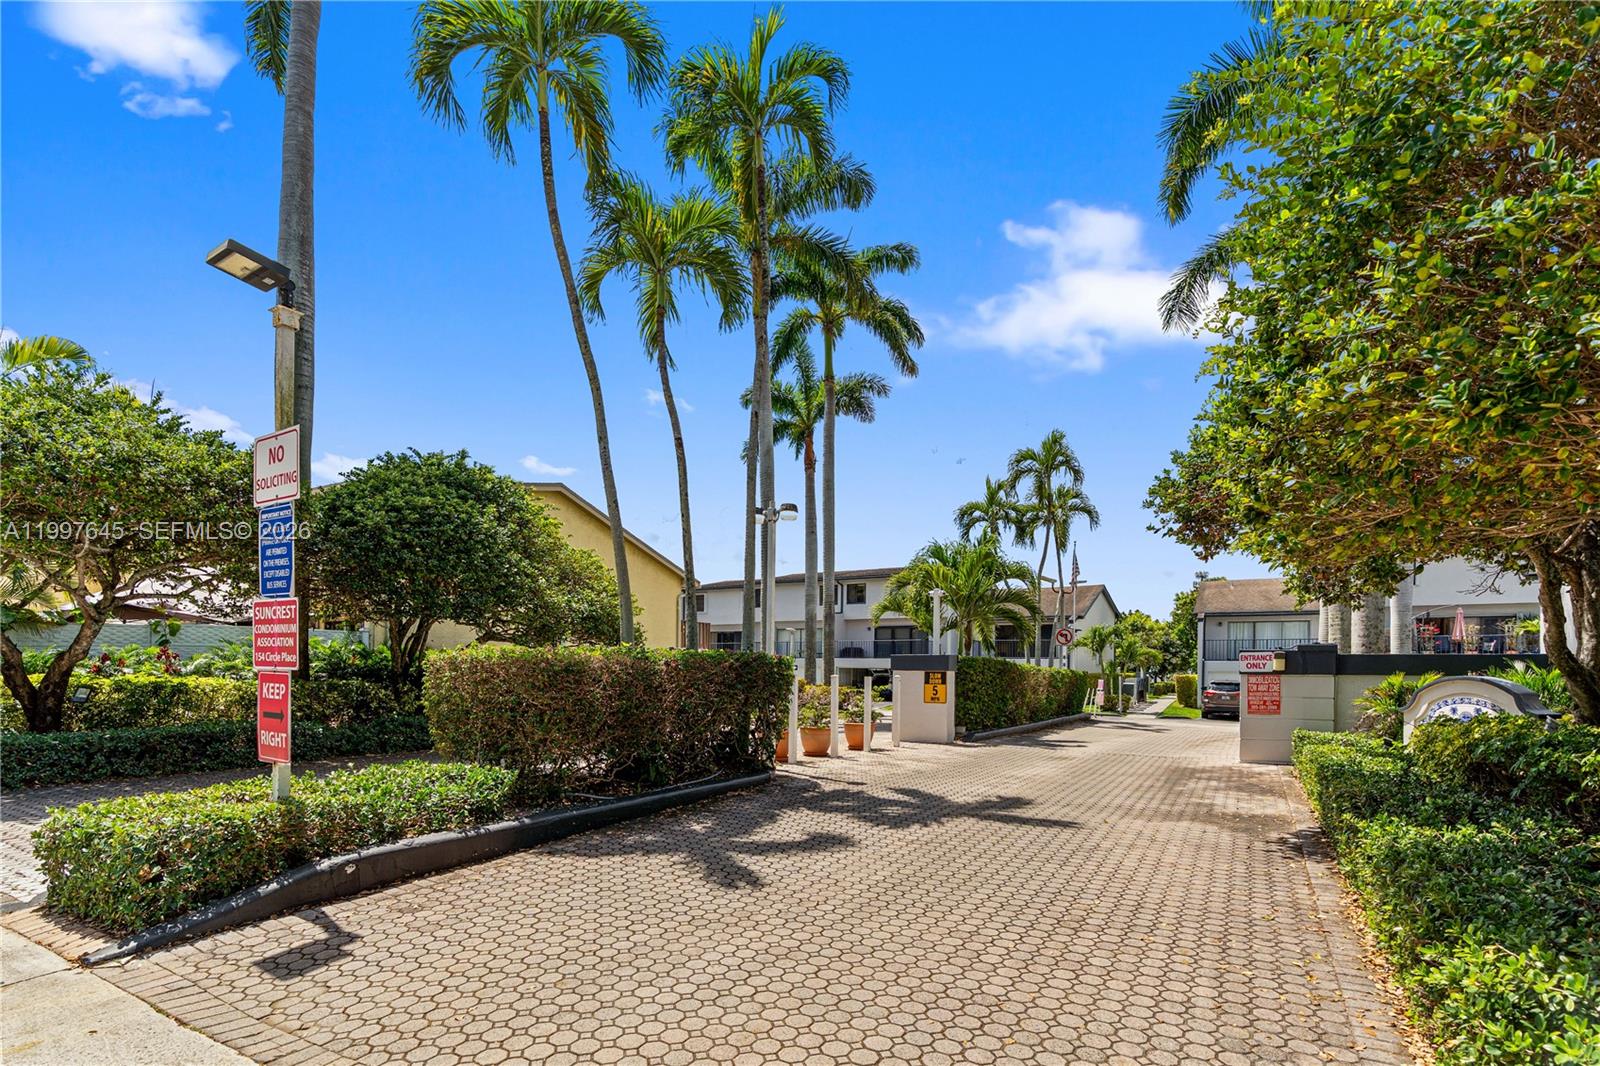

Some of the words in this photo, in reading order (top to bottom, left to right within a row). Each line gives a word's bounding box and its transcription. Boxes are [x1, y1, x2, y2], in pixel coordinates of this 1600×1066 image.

[268, 445, 285, 465] NO
[256, 470, 297, 491] SOLICITING
[255, 605, 296, 620] SUNCREST
[255, 623, 297, 634] CONDOMINIUM
[256, 637, 294, 648] ASSOCIATION
[255, 652, 265, 662] 154
[265, 651, 281, 662] Circle
[281, 651, 297, 662] Place
[1246, 662, 1267, 670] ONLY
[262, 682, 286, 700] KEEP
[932, 685, 938, 696] 5
[1258, 684, 1269, 692] AWAY
[1269, 683, 1280, 692] ZONE
[260, 729, 287, 748] RIGHT
